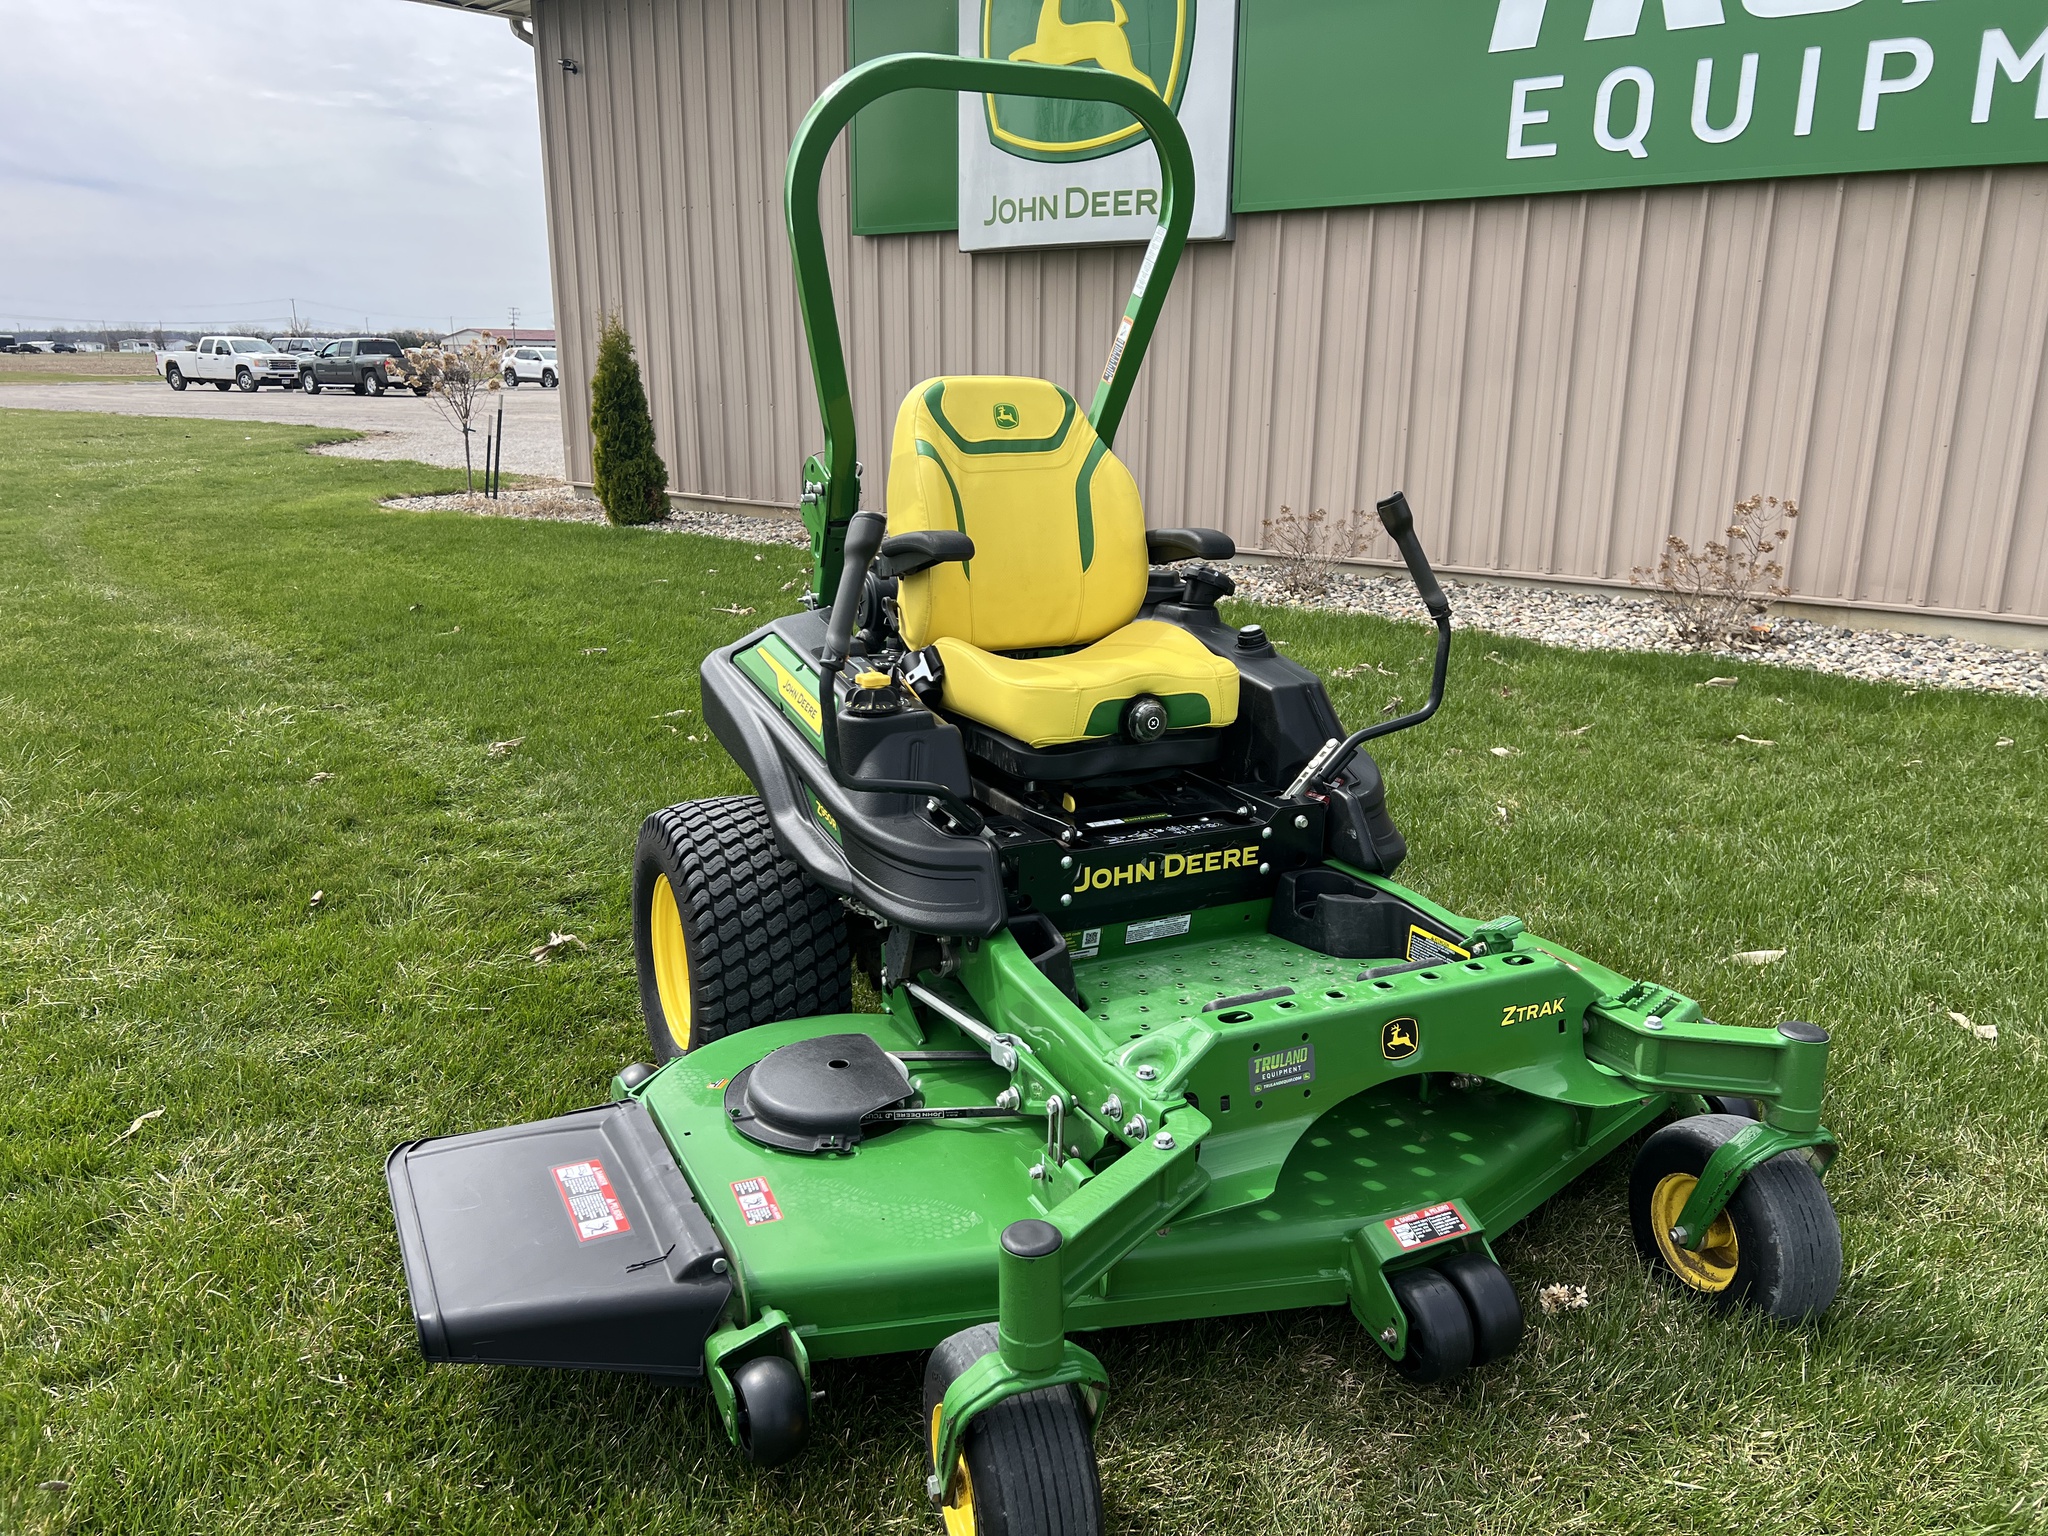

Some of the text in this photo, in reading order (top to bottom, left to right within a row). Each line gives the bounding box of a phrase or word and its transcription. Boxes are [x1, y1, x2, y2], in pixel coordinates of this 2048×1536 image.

[983, 186, 1159, 226] JOHN DEER
[782, 678, 818, 720] JOHN DEERE
[1073, 845, 1260, 893] JOHN DEERE
[1500, 996, 1567, 1028] ZTRAK
[1253, 1046, 1309, 1074] TRULAND
[1261, 1065, 1302, 1080] EQUIPMENT
